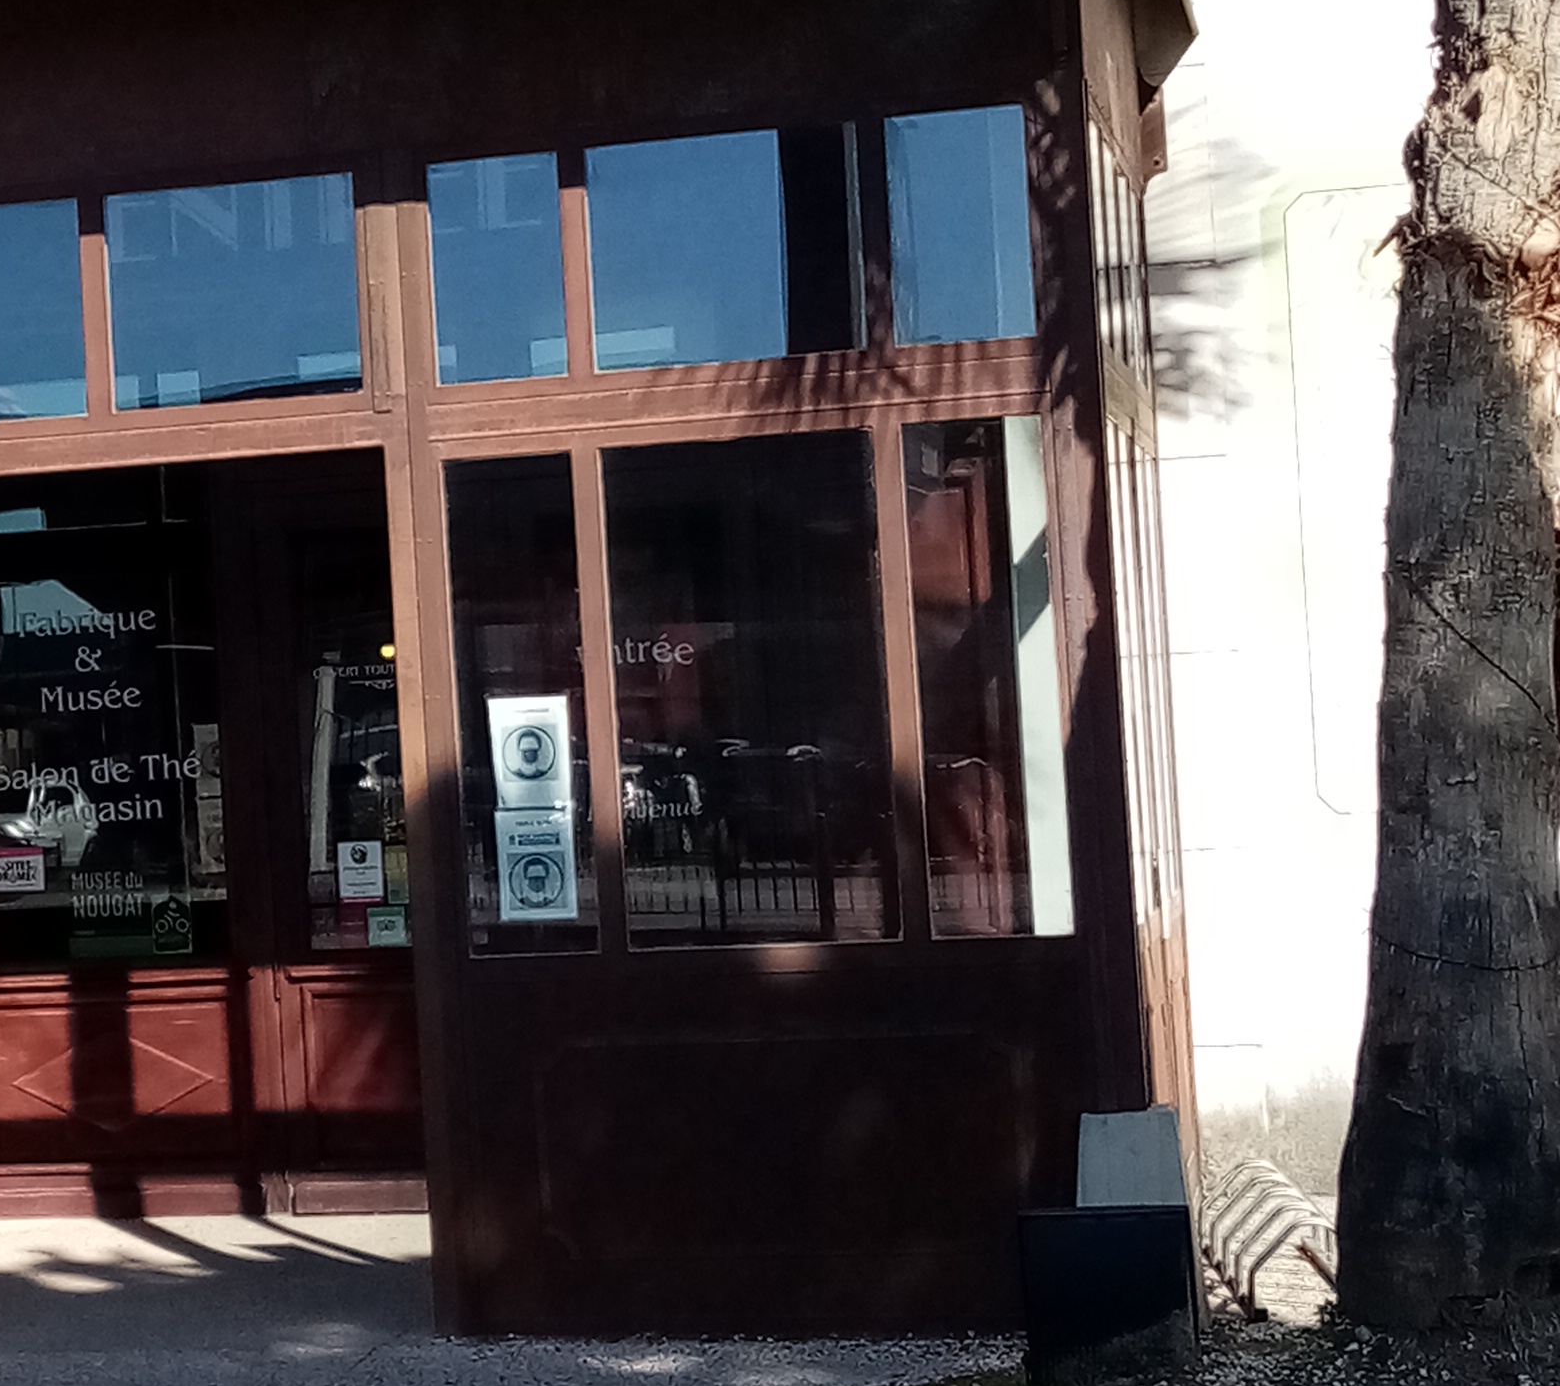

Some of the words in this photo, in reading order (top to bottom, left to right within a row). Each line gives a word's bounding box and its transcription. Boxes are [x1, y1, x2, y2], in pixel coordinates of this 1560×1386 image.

[18, 608, 157, 640] Fabrique
[74, 645, 102, 673] &
[40, 679, 142, 713] Musée
[91, 757, 132, 784] de
[140, 749, 202, 781] Thé
[71, 893, 145, 919] NOUGAT
